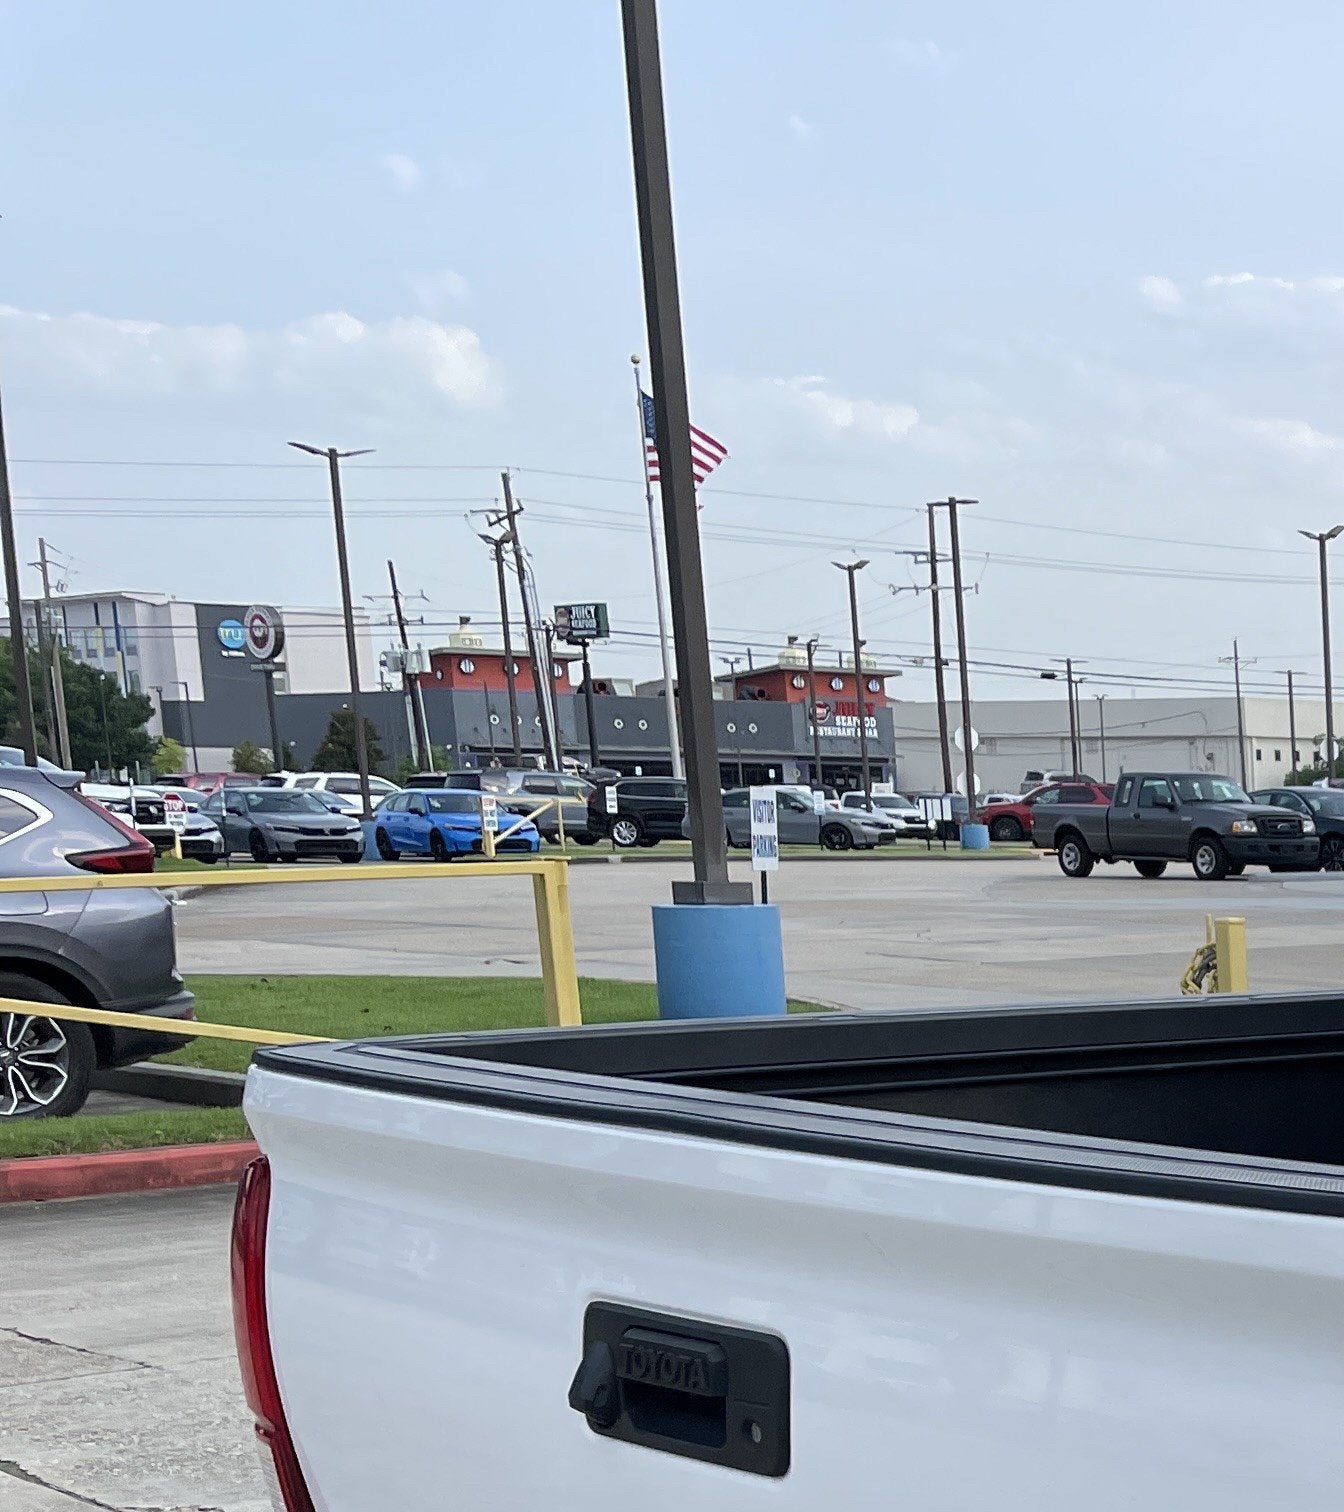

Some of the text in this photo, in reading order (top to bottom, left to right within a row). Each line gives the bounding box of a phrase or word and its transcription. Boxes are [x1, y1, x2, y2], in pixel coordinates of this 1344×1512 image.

[570, 605, 596, 619] JUICY
[752, 800, 776, 824] VISITOR
[752, 833, 778, 858] PARKING
[615, 1342, 709, 1392] TOYOTA
